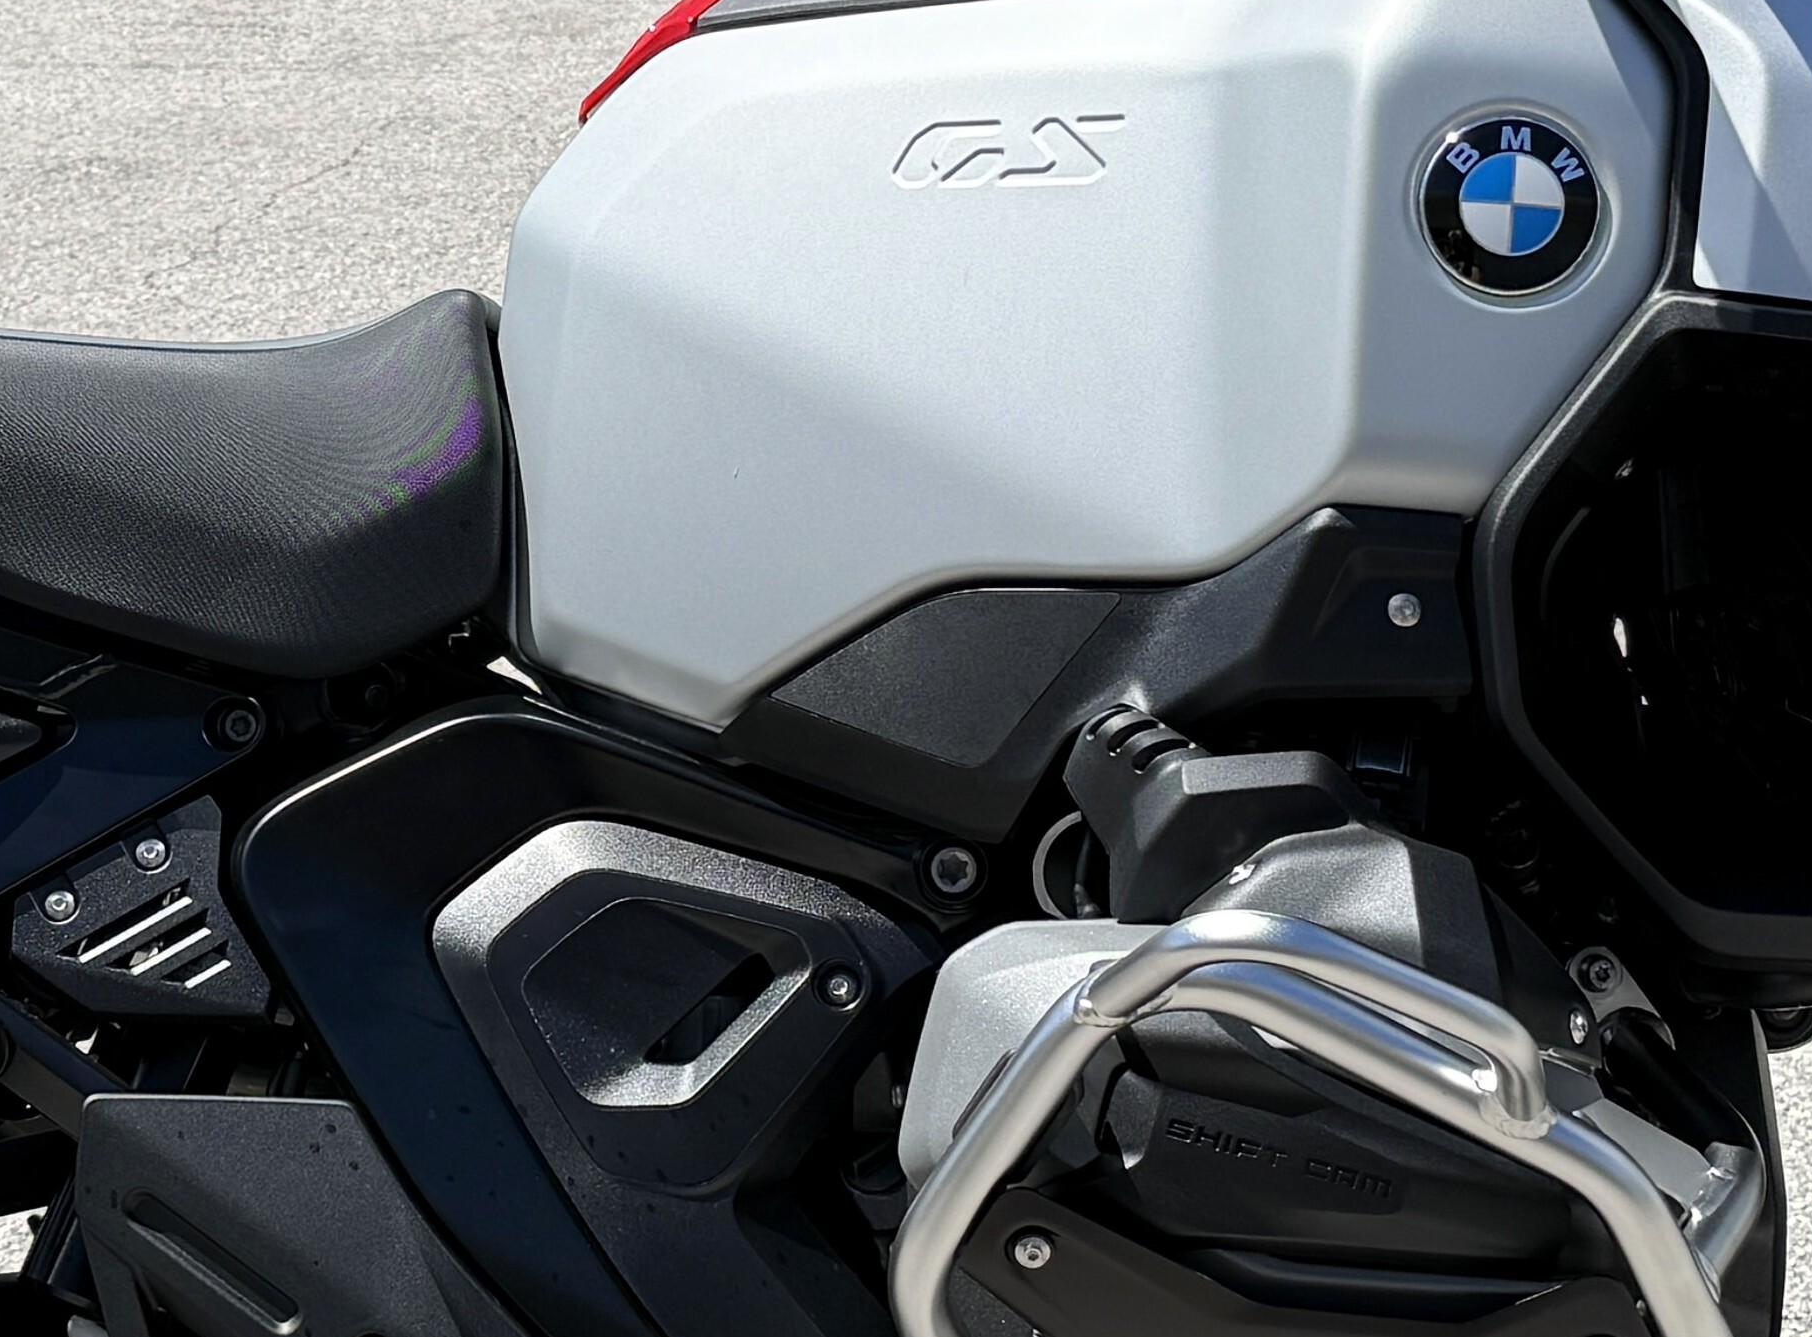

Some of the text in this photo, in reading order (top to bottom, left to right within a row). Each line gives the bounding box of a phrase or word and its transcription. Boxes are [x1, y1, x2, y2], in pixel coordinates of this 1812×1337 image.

[890, 112, 1126, 190] GS
[1444, 125, 1586, 185] BMW
[1166, 1118, 1287, 1167] SHIFT
